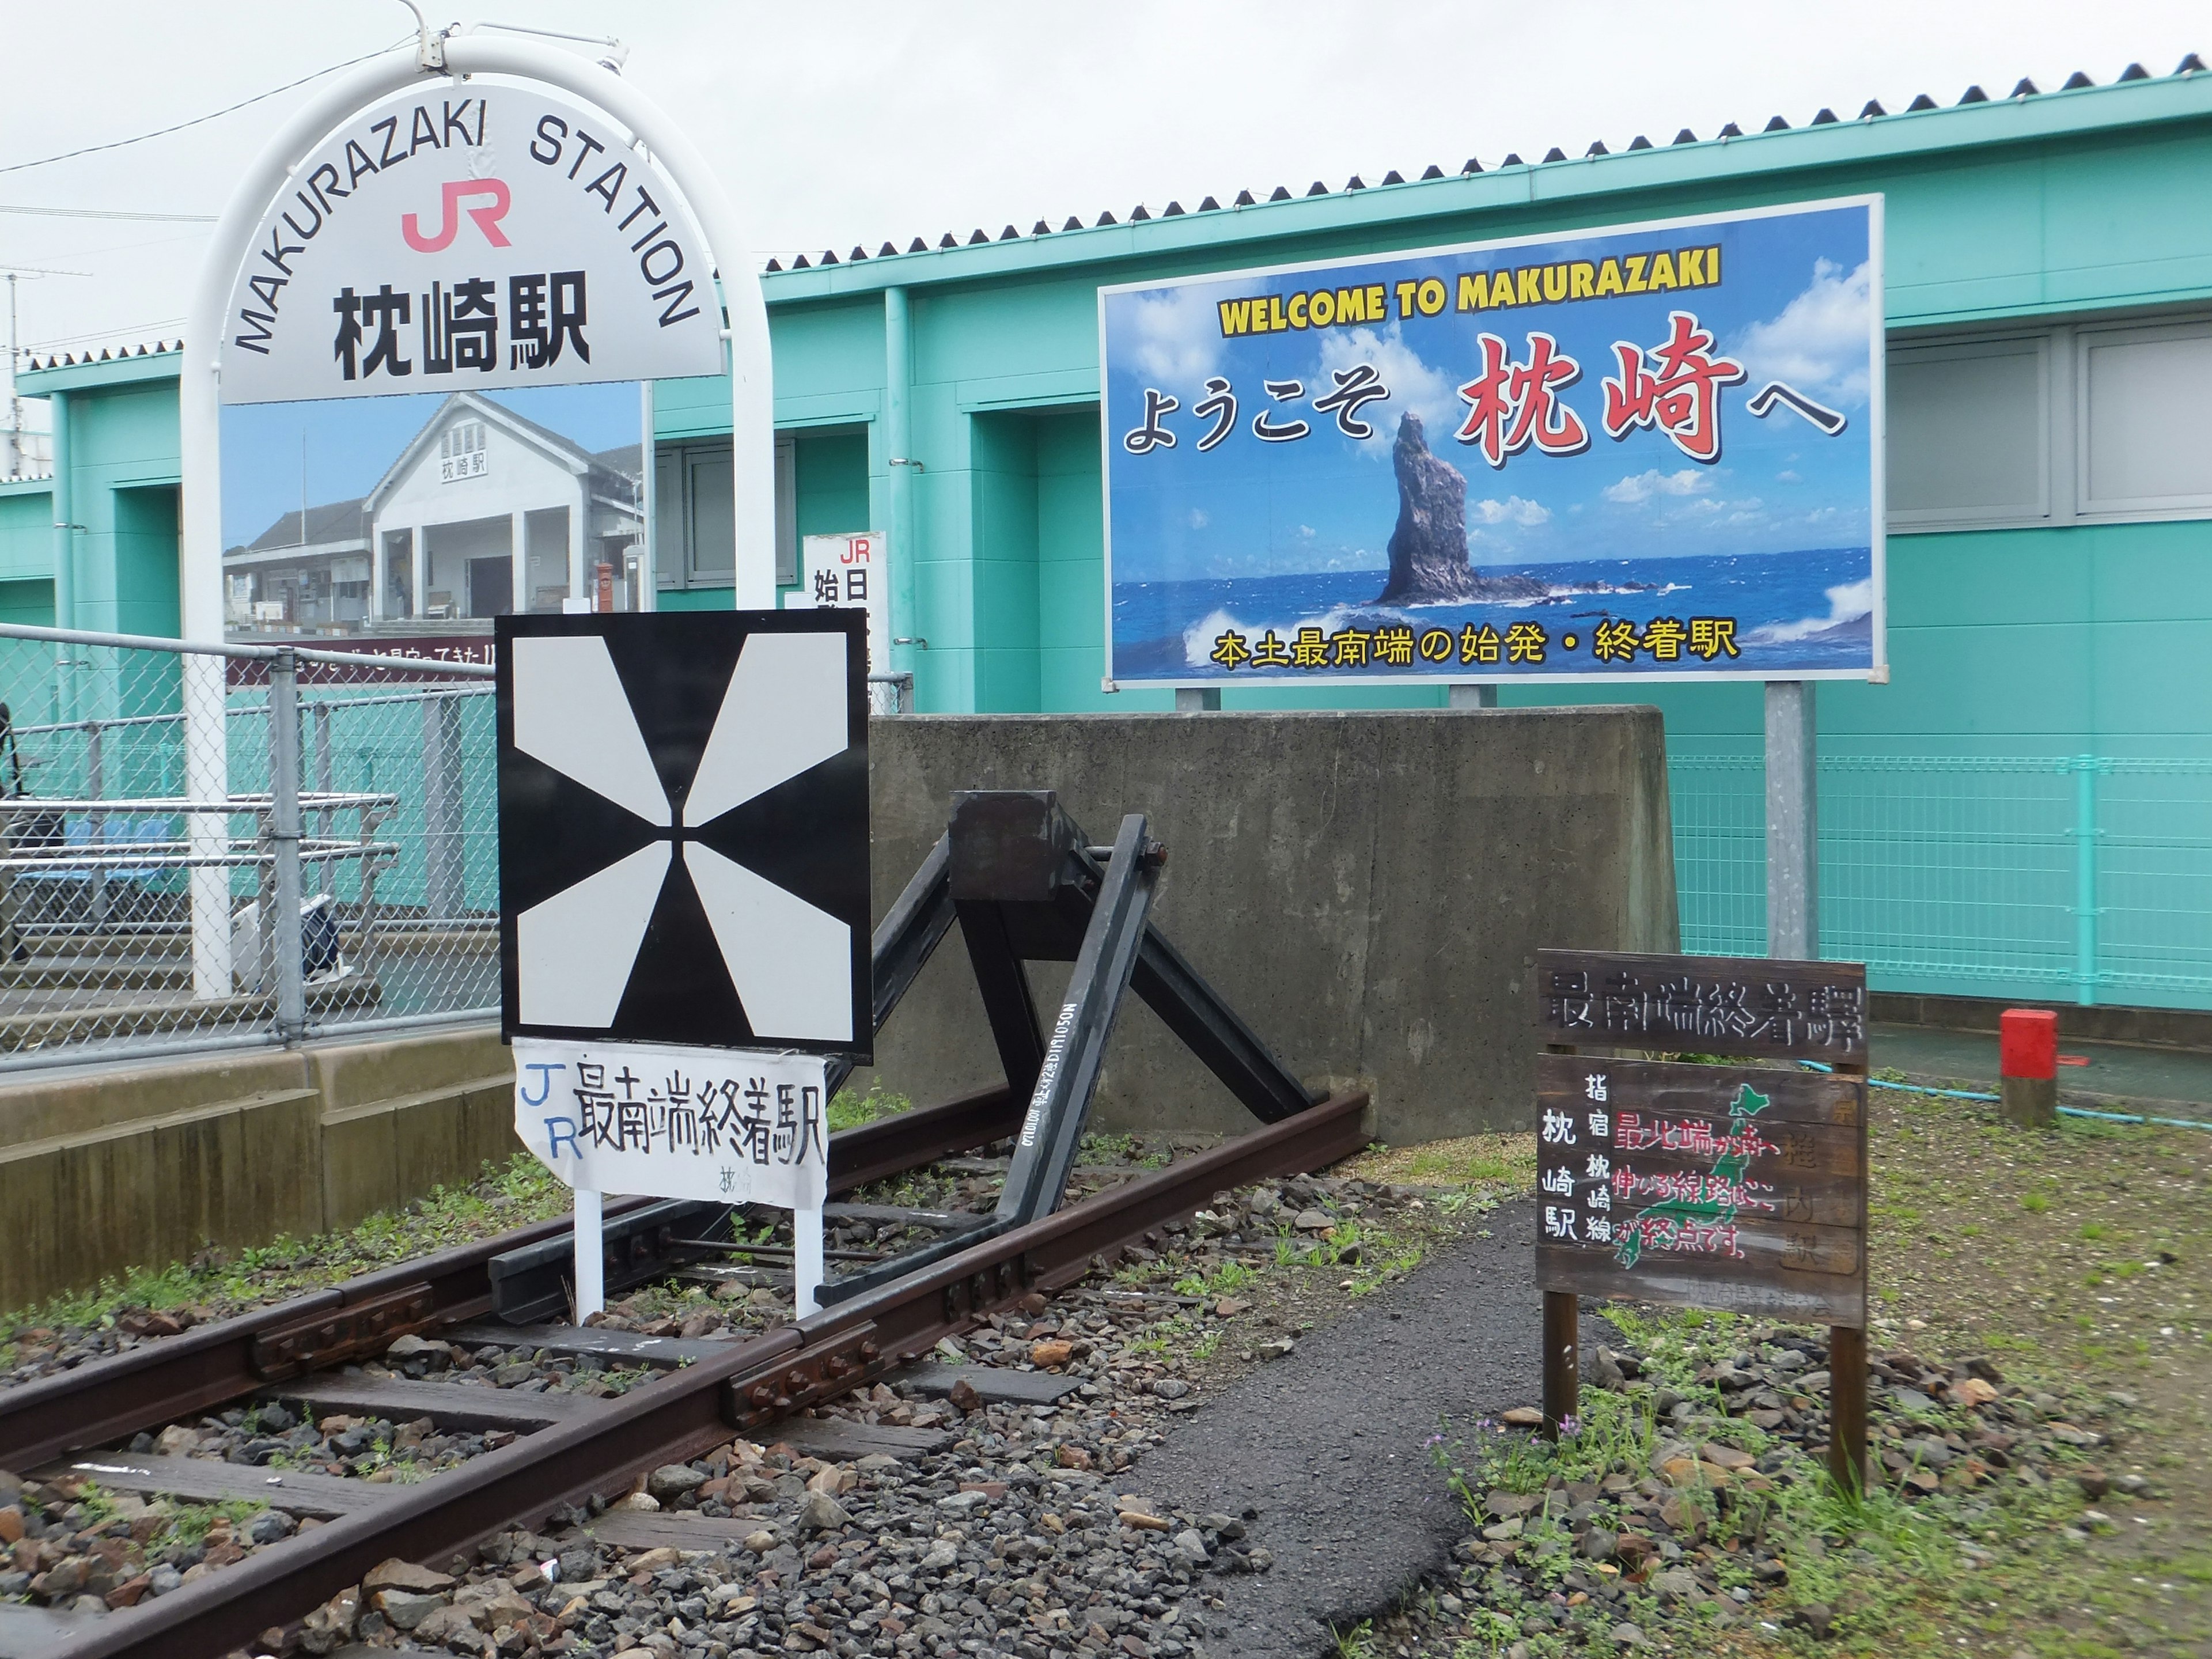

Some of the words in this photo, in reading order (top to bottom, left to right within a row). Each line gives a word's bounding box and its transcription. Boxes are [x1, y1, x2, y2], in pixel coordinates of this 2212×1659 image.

[235, 99, 486, 355] MAKURAZAKI
[529, 114, 701, 328] STATION
[401, 178, 512, 253] JR
[333, 270, 590, 380] 枕崎駅
[1218, 287, 1385, 336] WELCOME
[1397, 278, 1447, 317] TO
[1457, 245, 1721, 312] MAKURAZAKI
[1124, 363, 1389, 452] ようこそ
[442, 452, 484, 479] 枕崎駅
[840, 539, 870, 564] JR
[1211, 617, 1740, 669] 本土最南端の始発・終着駅
[573, 1062, 825, 1165] 最南端終着駅
[1542, 1108, 1578, 1240] 枕崎駅
